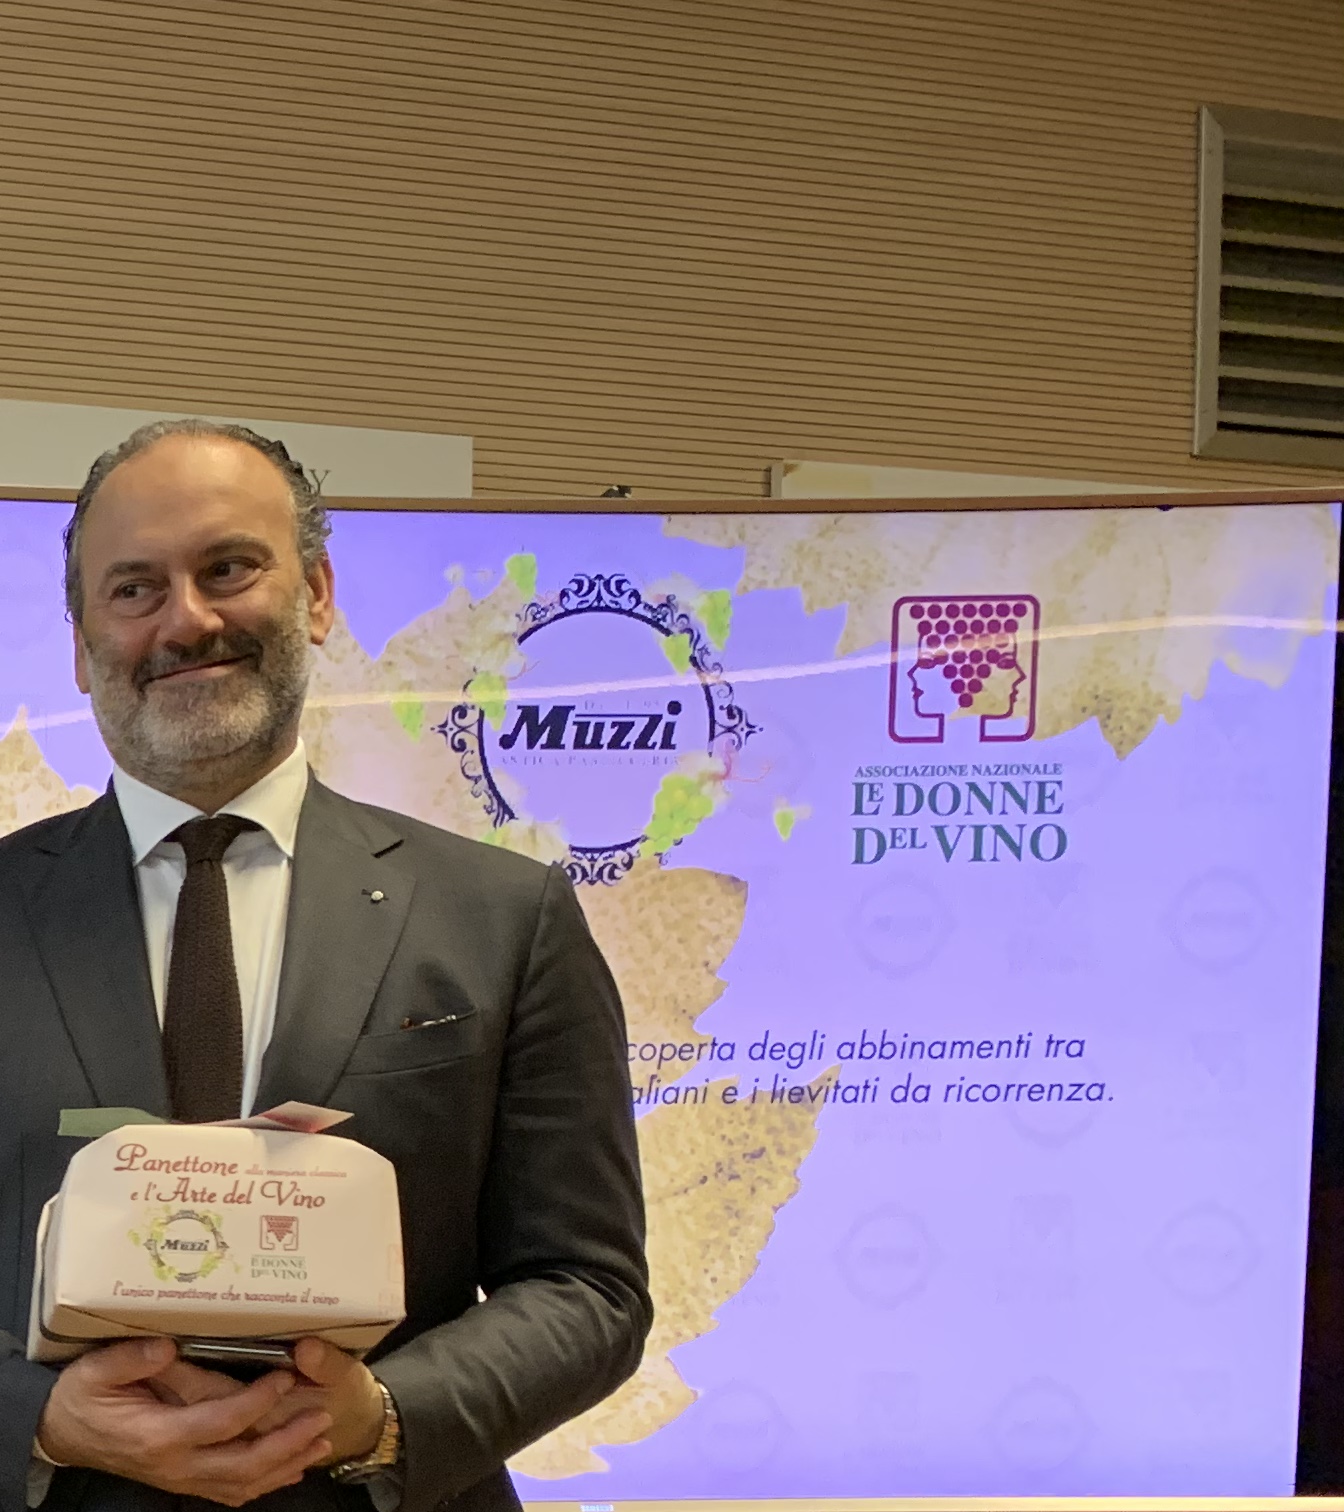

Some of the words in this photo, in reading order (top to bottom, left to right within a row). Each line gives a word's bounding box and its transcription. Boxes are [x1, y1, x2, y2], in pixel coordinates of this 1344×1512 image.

[499, 700, 683, 750] Muzzi
[854, 764, 969, 778] ASSOCIAZIONE
[972, 763, 1064, 776] NAZIONALE
[892, 780, 1065, 816] DONNE
[930, 823, 1068, 864] VINO
[748, 1030, 827, 1069] degli
[837, 1030, 1034, 1062] abbinamenti
[1045, 1033, 1087, 1060] tra
[721, 1083, 739, 1104] e
[751, 1077, 761, 1104] i
[771, 1073, 879, 1105] lievitati
[890, 1074, 932, 1104] da
[943, 1076, 1115, 1104] ricorrenza.
[113, 1143, 239, 1176] Panettone
[130, 1191, 139, 1201] e
[143, 1176, 217, 1204] l'Arte
[223, 1179, 256, 1205] del
[261, 1179, 326, 1209] Vino
[272, 1269, 309, 1282] VINO
